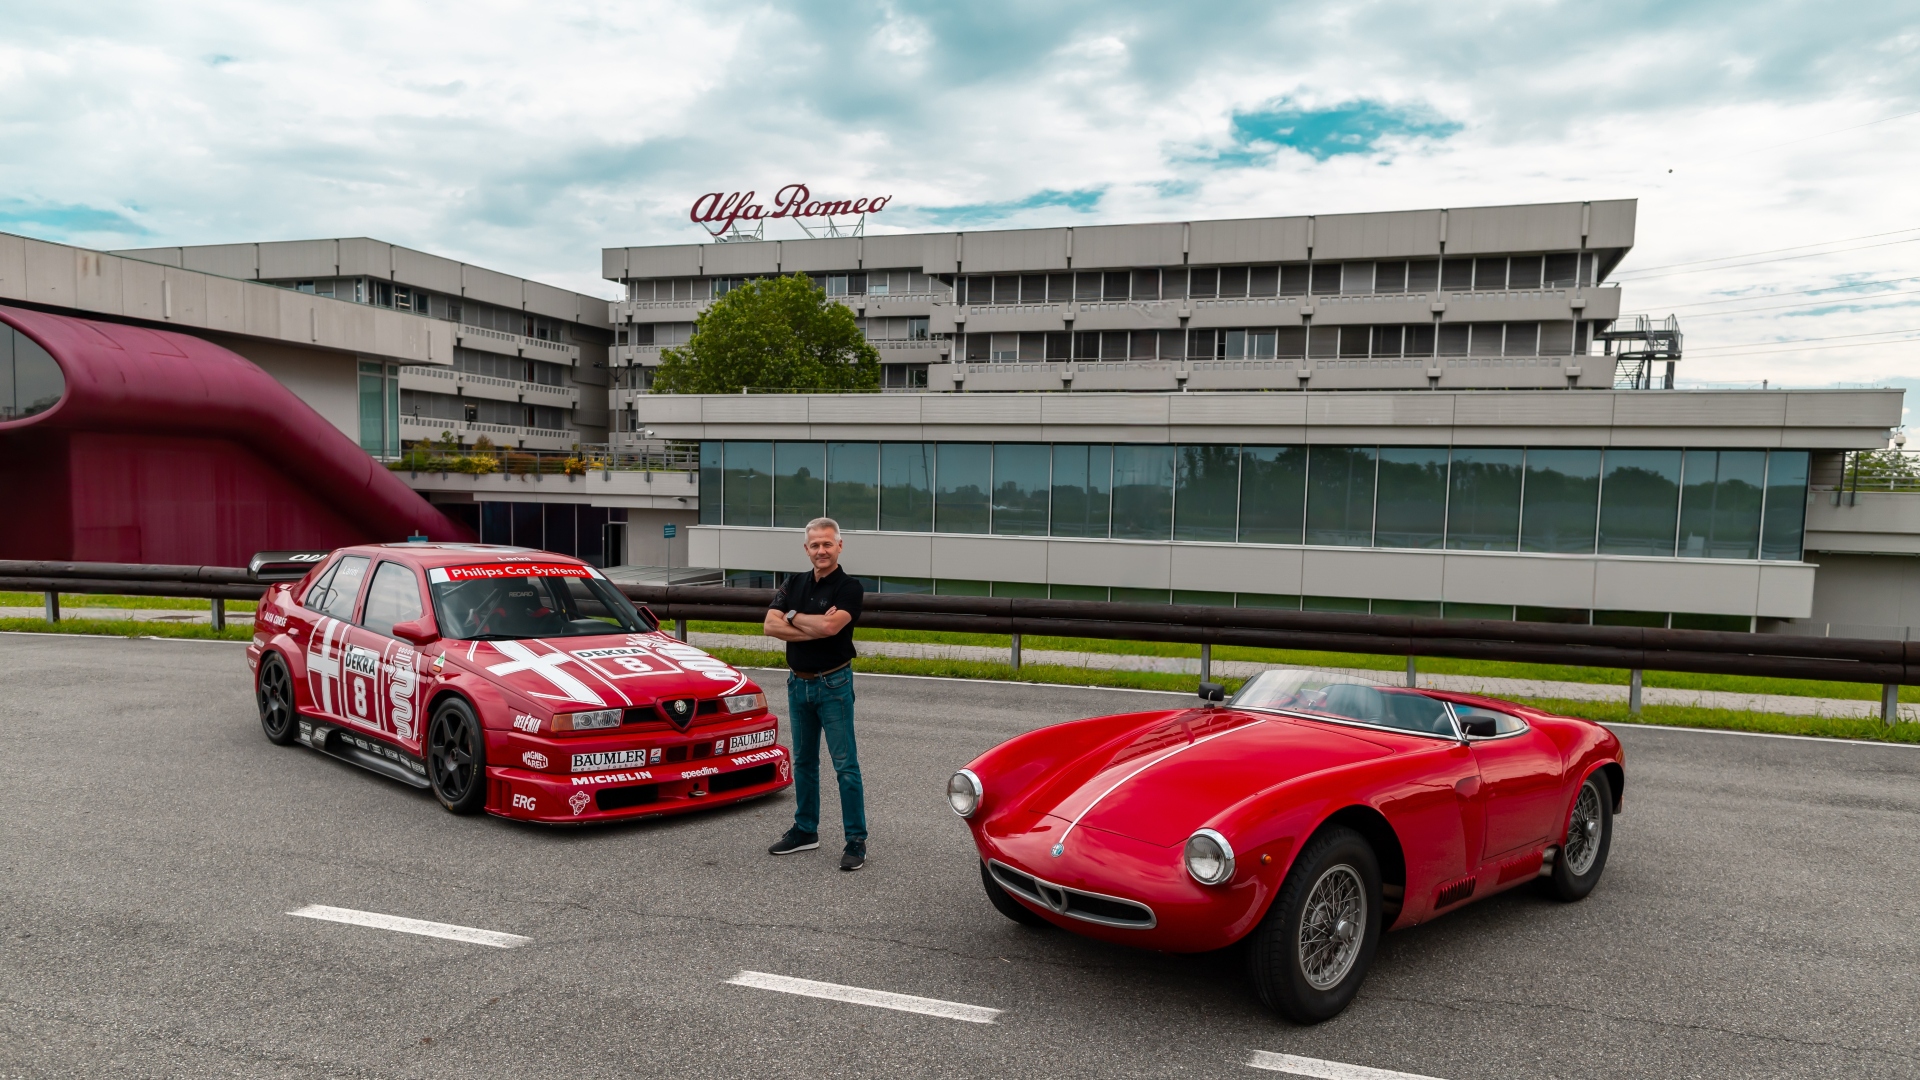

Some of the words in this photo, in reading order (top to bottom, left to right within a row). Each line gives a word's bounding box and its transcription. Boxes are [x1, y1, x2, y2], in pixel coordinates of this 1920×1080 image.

[690, 190, 770, 236] Alfa
[770, 183, 892, 218] Romeo
[451, 567, 504, 578] Philips
[505, 566, 531, 575] Car
[532, 566, 586, 576] Systems
[576, 648, 647, 658] DEKRA
[345, 652, 376, 676] DEKRA
[613, 657, 653, 672] 8
[354, 676, 367, 717] 8
[573, 750, 645, 767] BÄUMLER
[731, 748, 784, 766] MICHELIN
[571, 771, 653, 786] MICHELIN
[681, 766, 719, 780] speedline
[512, 793, 537, 811] ERG
